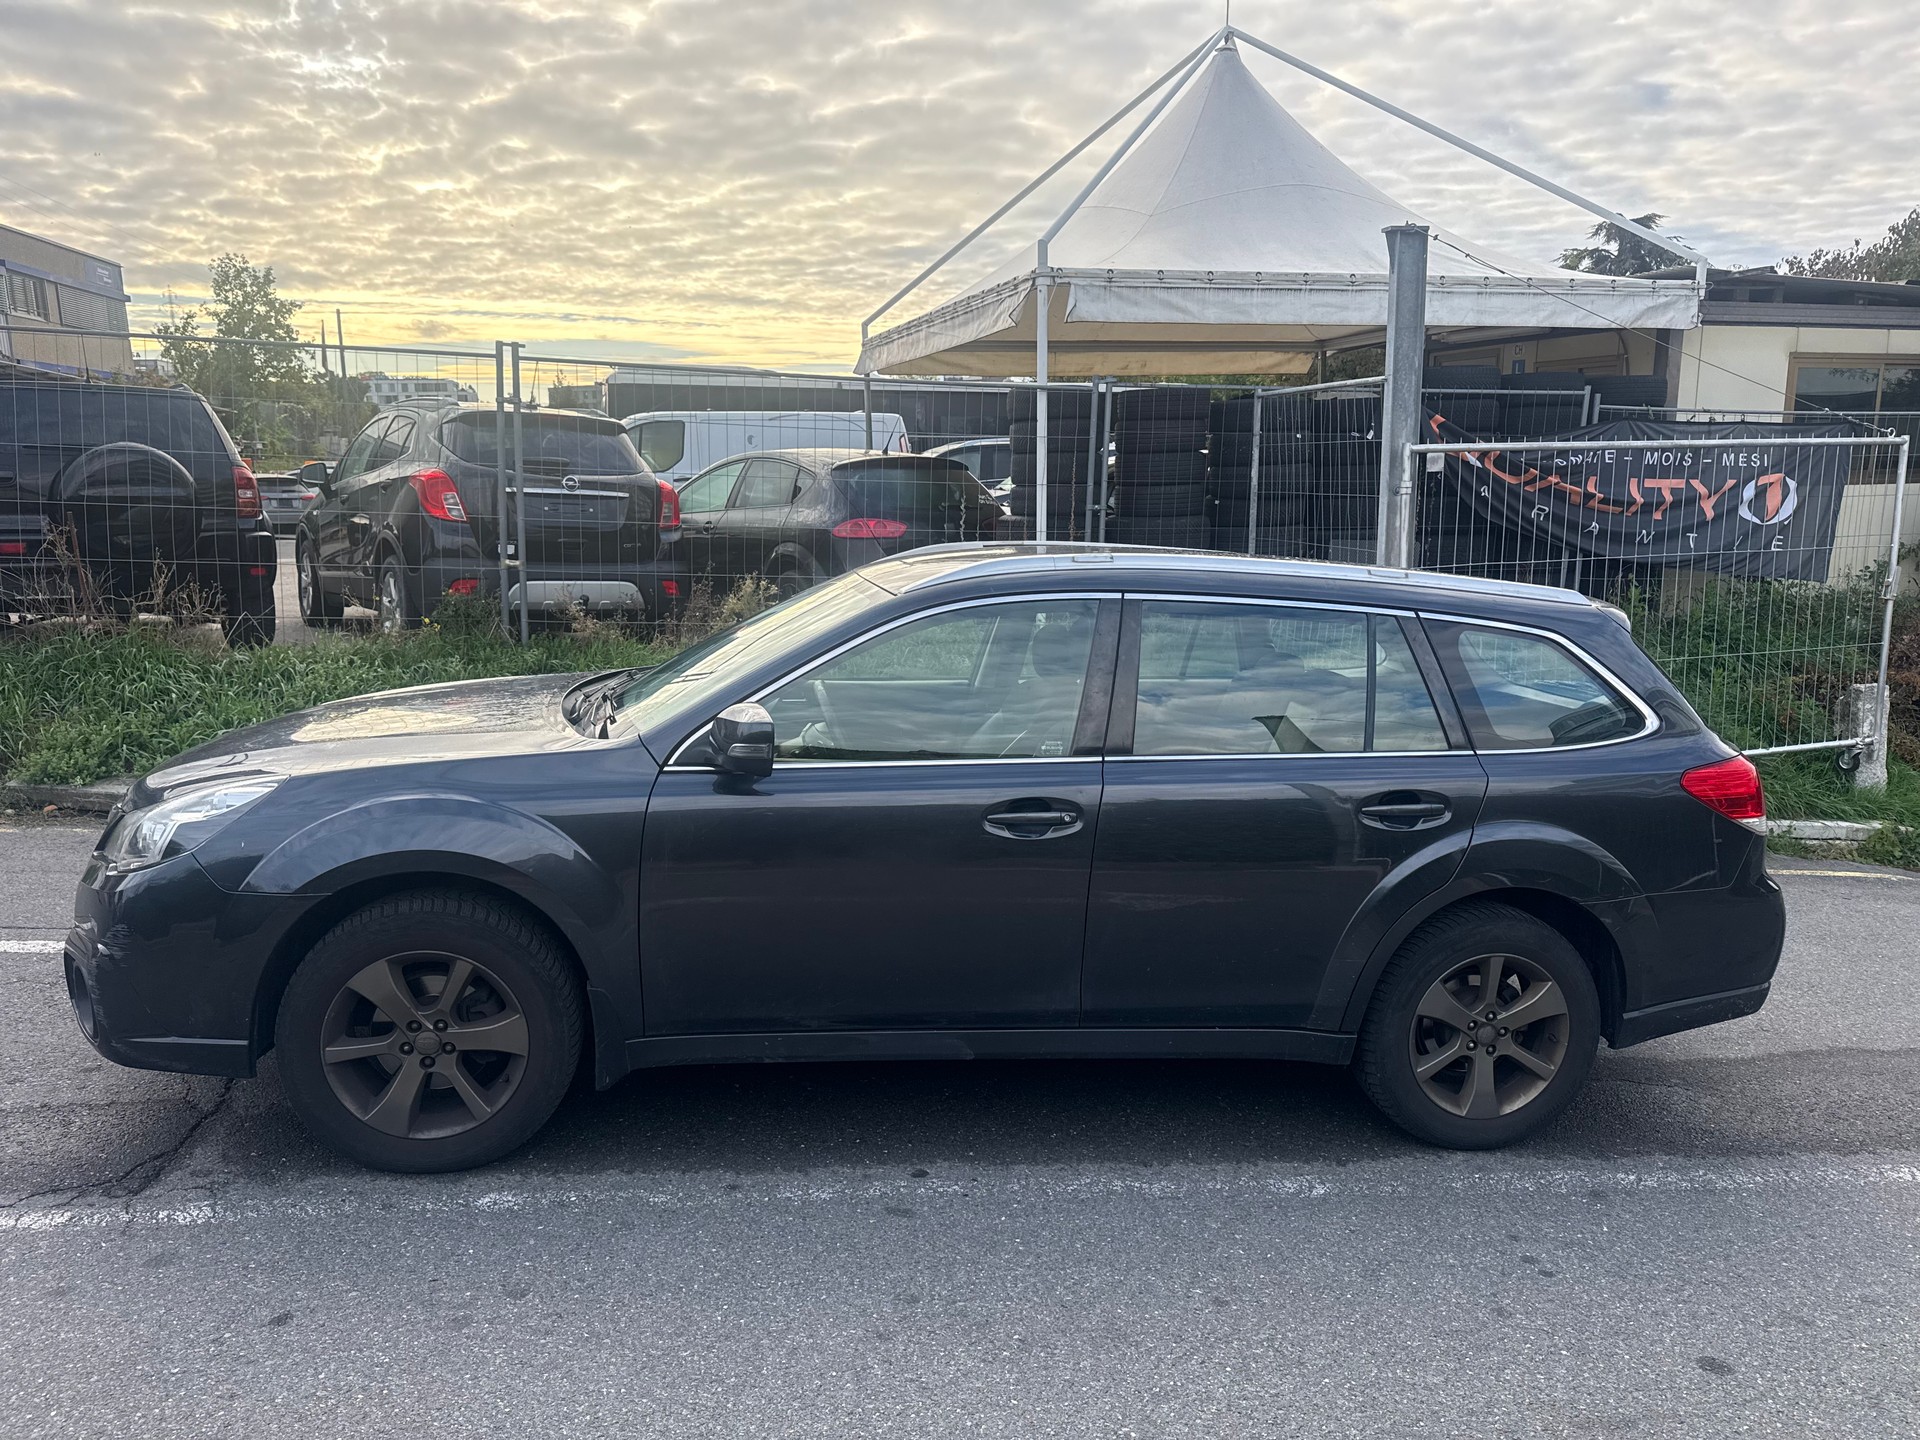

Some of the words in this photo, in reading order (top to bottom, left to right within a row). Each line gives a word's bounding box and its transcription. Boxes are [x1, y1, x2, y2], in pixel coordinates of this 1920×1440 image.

[1644, 451, 1693, 467] MOIS
[1722, 453, 1768, 467] MESI
[1437, 472, 1784, 551] ARANTIE
